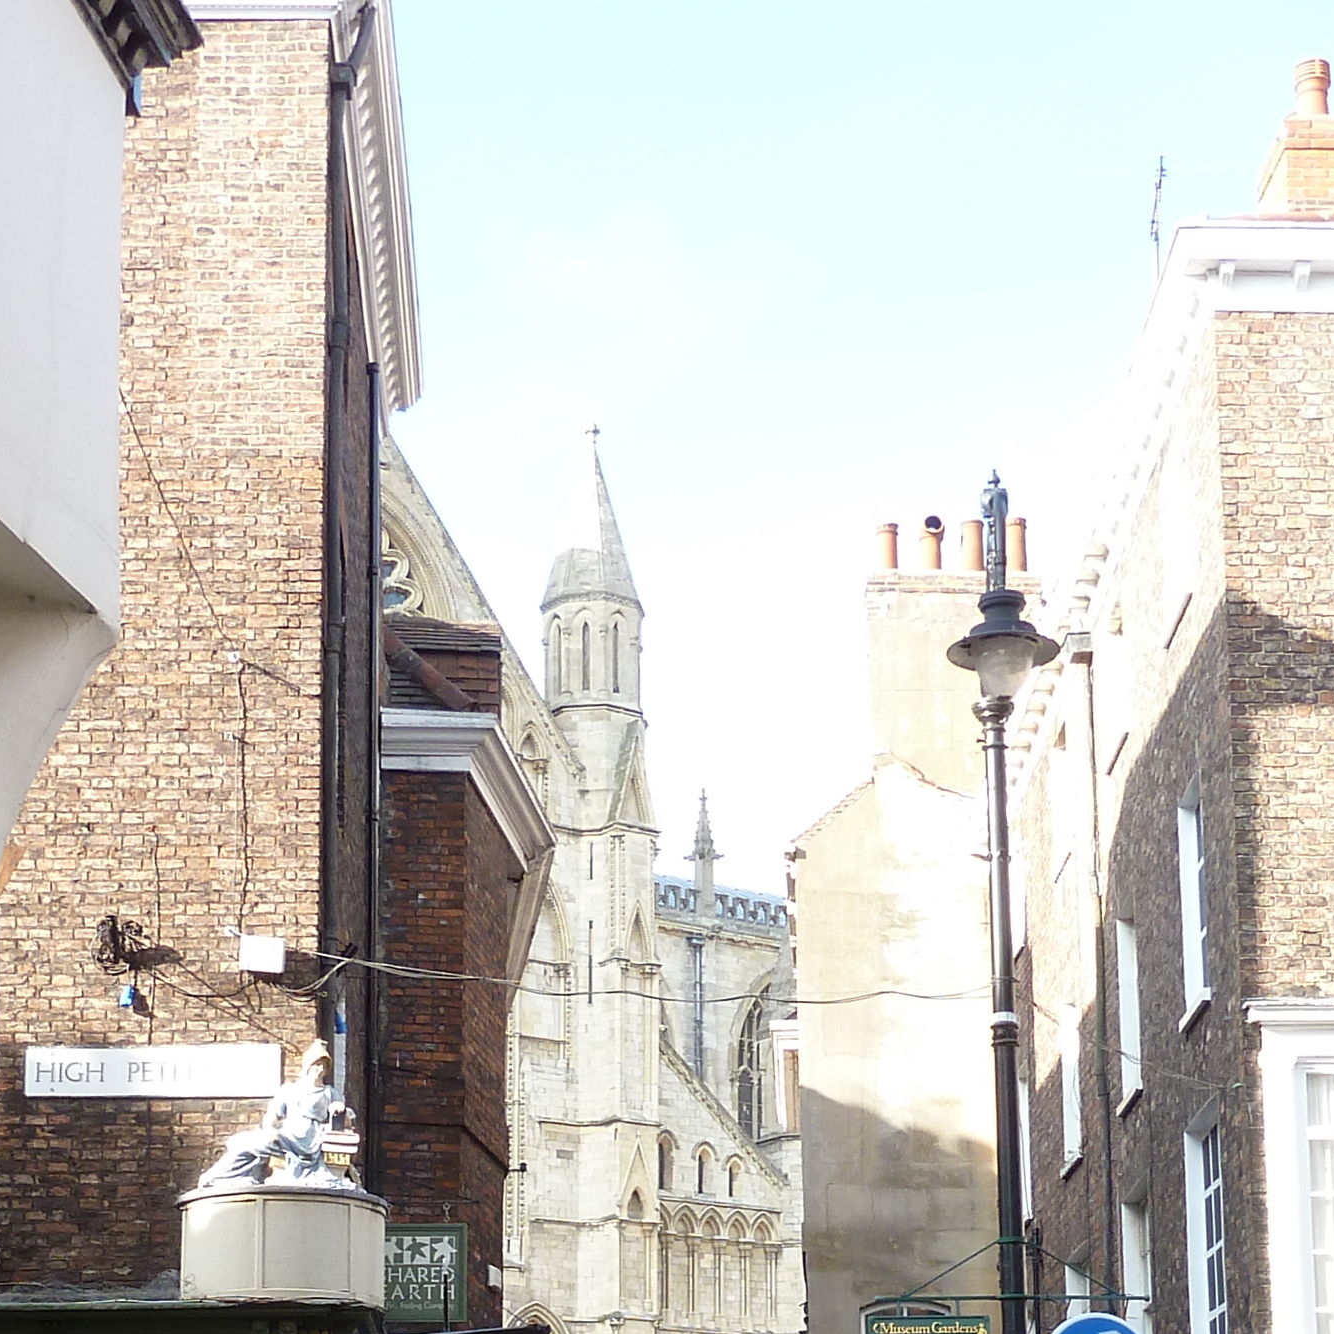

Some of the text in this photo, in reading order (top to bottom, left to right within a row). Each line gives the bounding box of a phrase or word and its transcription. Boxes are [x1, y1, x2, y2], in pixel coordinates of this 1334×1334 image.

[35, 1061, 106, 1083] HIGH
[385, 1267, 455, 1283] HARED
[384, 1284, 455, 1300] ARTH
[879, 1321, 978, 1334] Museum Gardens
